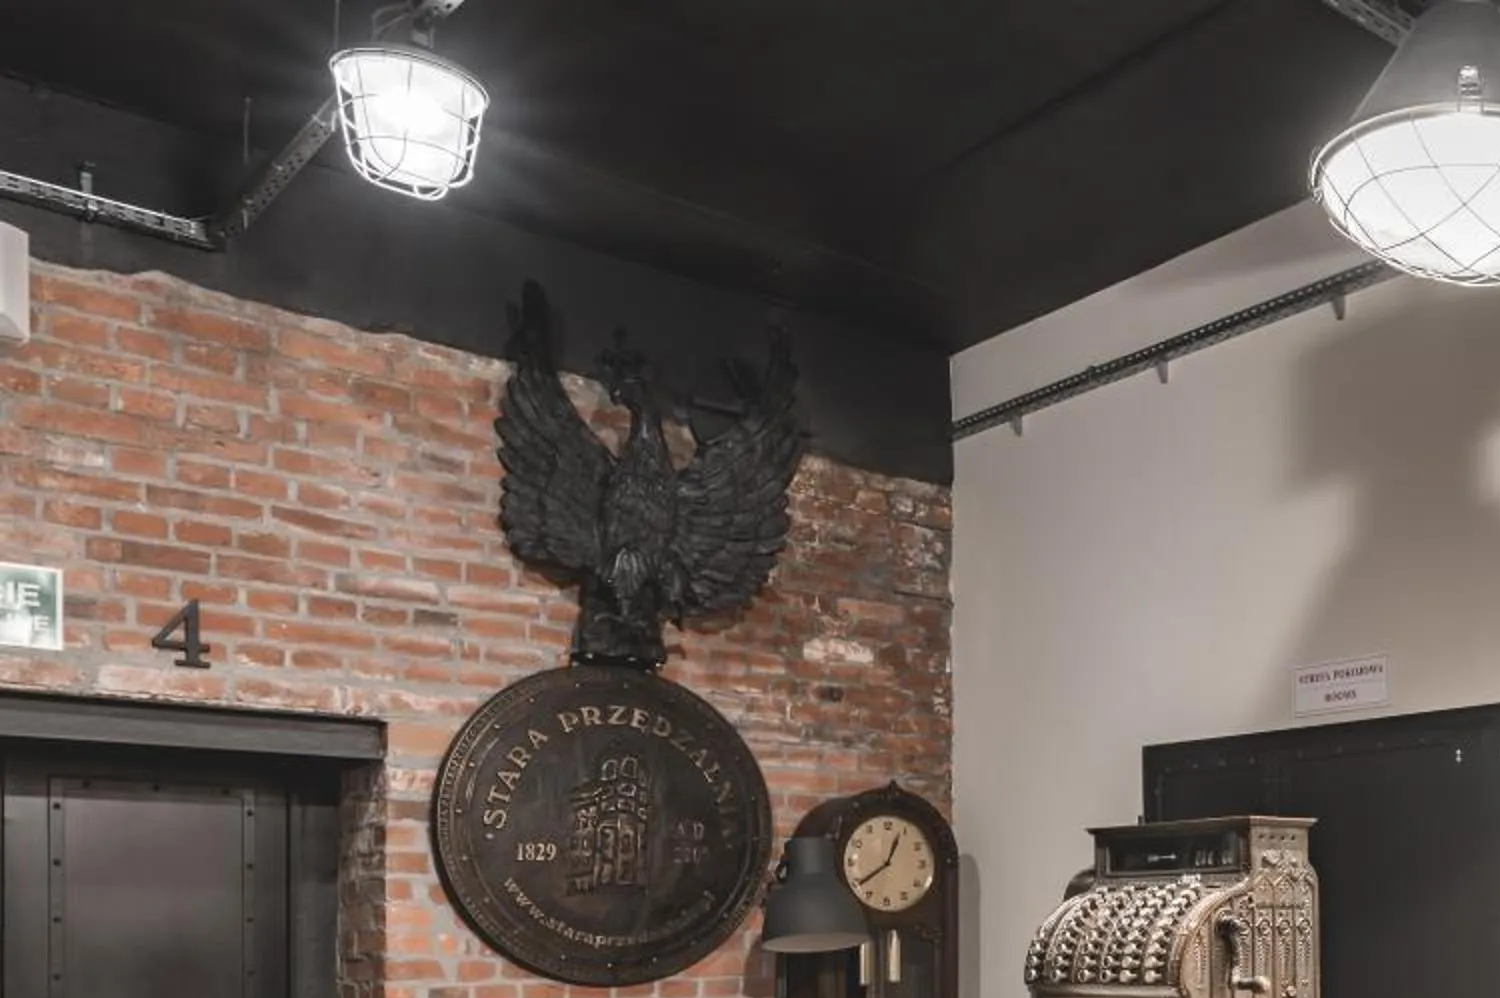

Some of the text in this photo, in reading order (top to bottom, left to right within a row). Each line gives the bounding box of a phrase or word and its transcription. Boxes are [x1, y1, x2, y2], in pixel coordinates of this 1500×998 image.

[151, 597, 211, 668] 4
[483, 726, 549, 830] STARA
[516, 842, 558, 862] 1829
